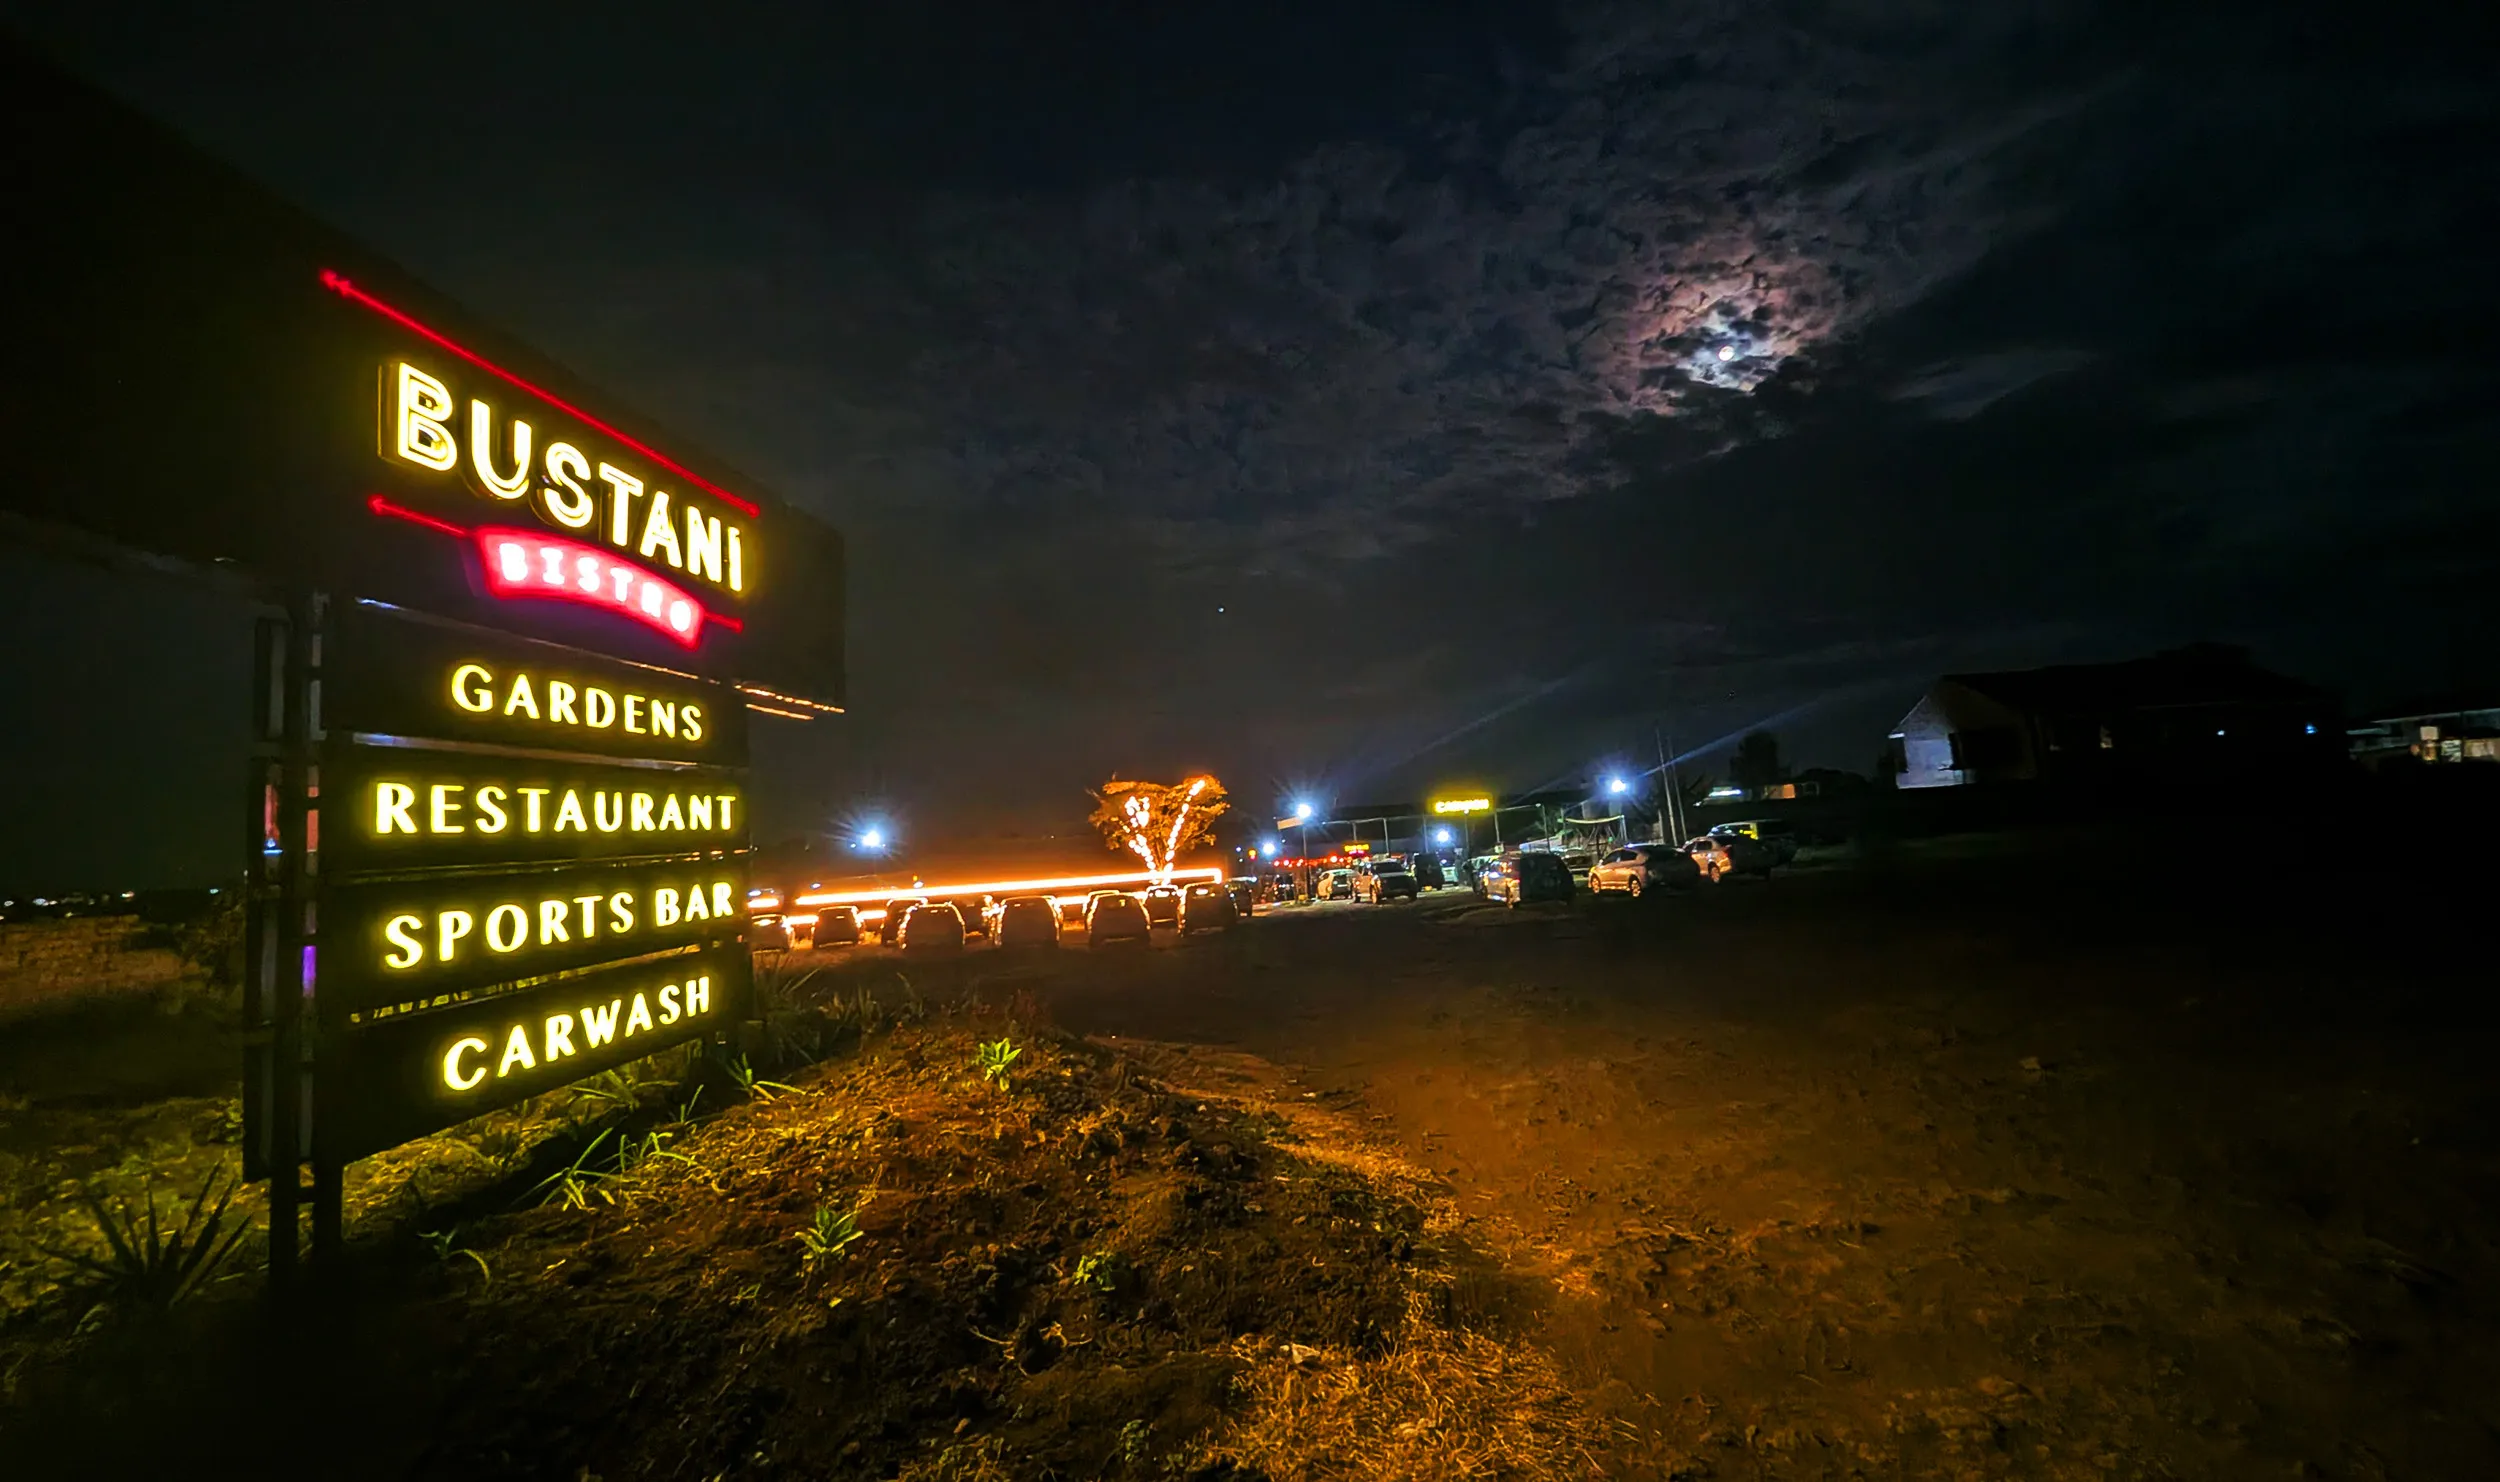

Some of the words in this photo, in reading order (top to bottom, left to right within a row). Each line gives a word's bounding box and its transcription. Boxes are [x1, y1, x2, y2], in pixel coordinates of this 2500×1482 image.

[396, 361, 742, 592] BUSTANI
[500, 542, 693, 632] BISTRO
[451, 664, 703, 741] GARDENS
[375, 782, 737, 835] RESTAURANT
[384, 891, 635, 969] SPORTS
[653, 881, 735, 928] BAR
[443, 975, 711, 1091] CARWASH
